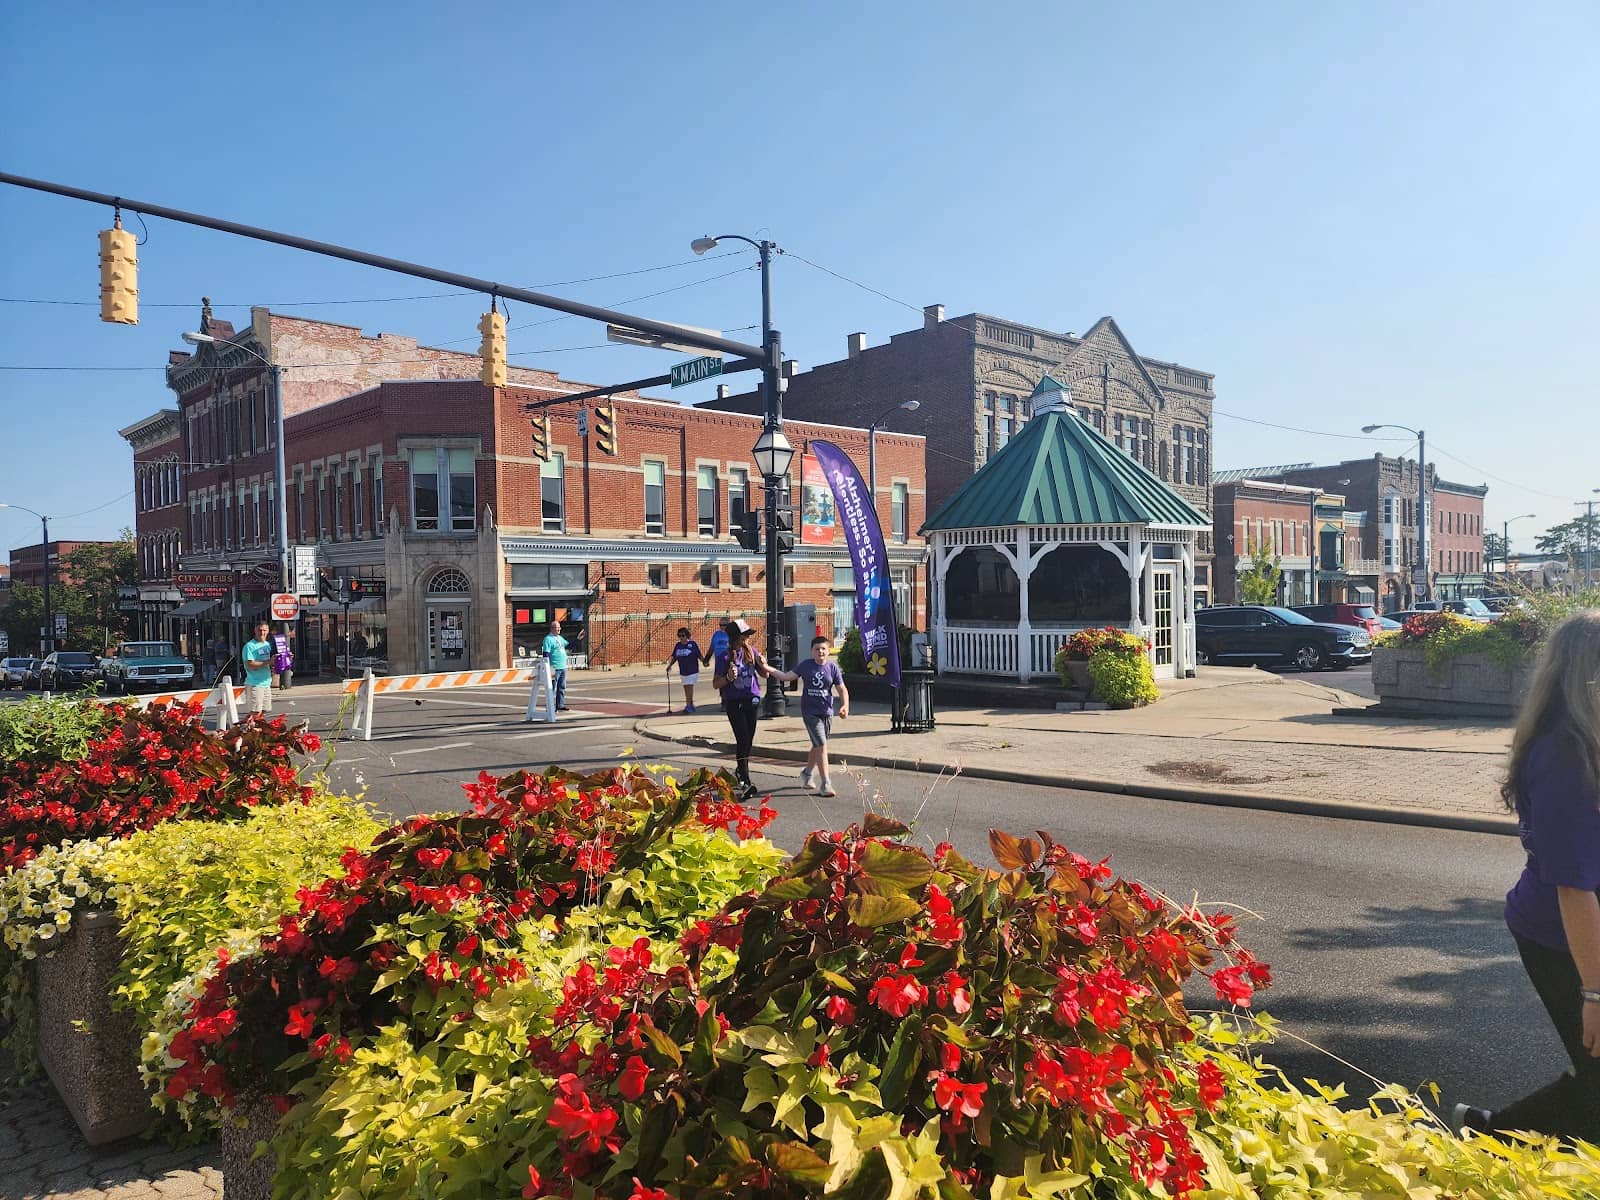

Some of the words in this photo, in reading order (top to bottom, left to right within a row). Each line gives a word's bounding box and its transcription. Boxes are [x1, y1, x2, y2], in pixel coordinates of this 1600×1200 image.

[681, 358, 709, 383] MAIN
[832, 469, 861, 546] relentless.
[859, 547, 867, 569] So
[863, 571, 871, 596] are
[845, 476, 876, 564] Alzheimer's
[178, 574, 201, 582] CITY
